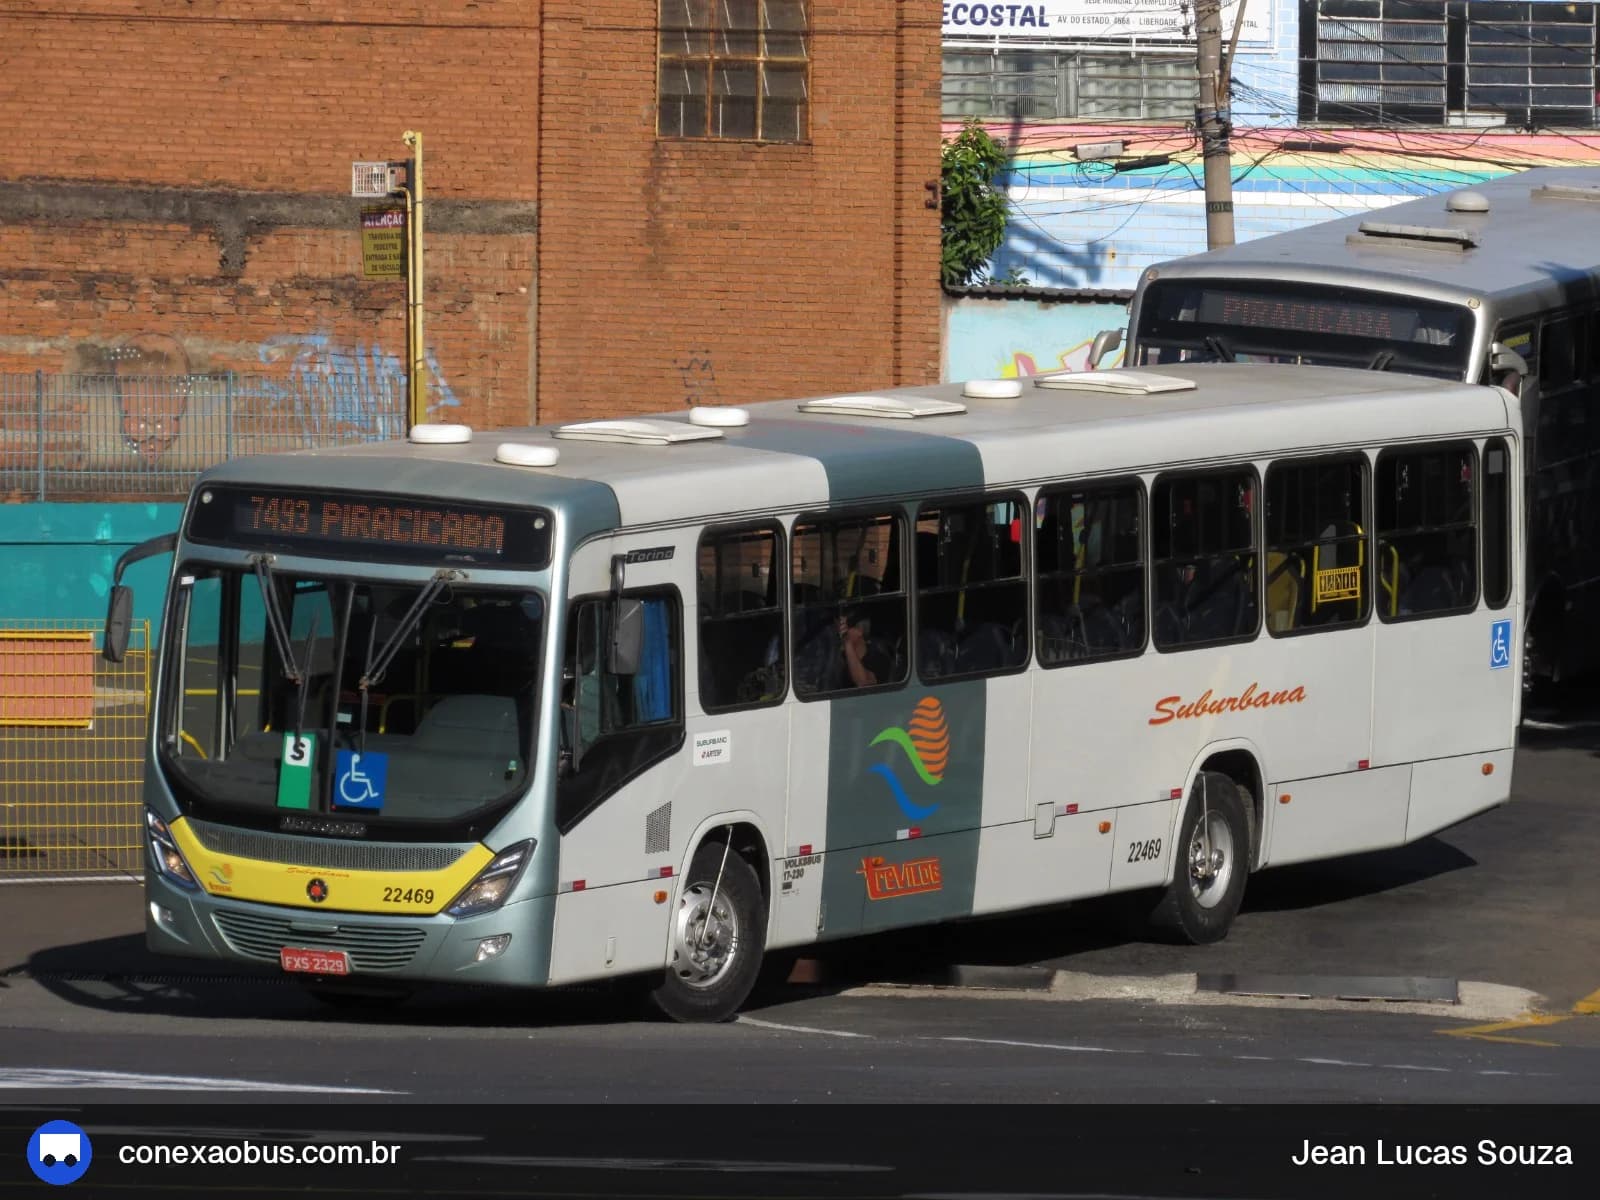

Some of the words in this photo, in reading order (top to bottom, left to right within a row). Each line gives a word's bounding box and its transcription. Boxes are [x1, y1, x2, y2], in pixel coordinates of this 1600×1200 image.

[943, 3, 1049, 27] ECOSTAL
[1070, 16, 1080, 24] DO
[252, 497, 310, 533] 7493
[321, 503, 505, 550] PIRACICABA
[1148, 682, 1306, 725] Suburbana
[1127, 838, 1162, 863] 22469
[383, 887, 434, 904] 22469
